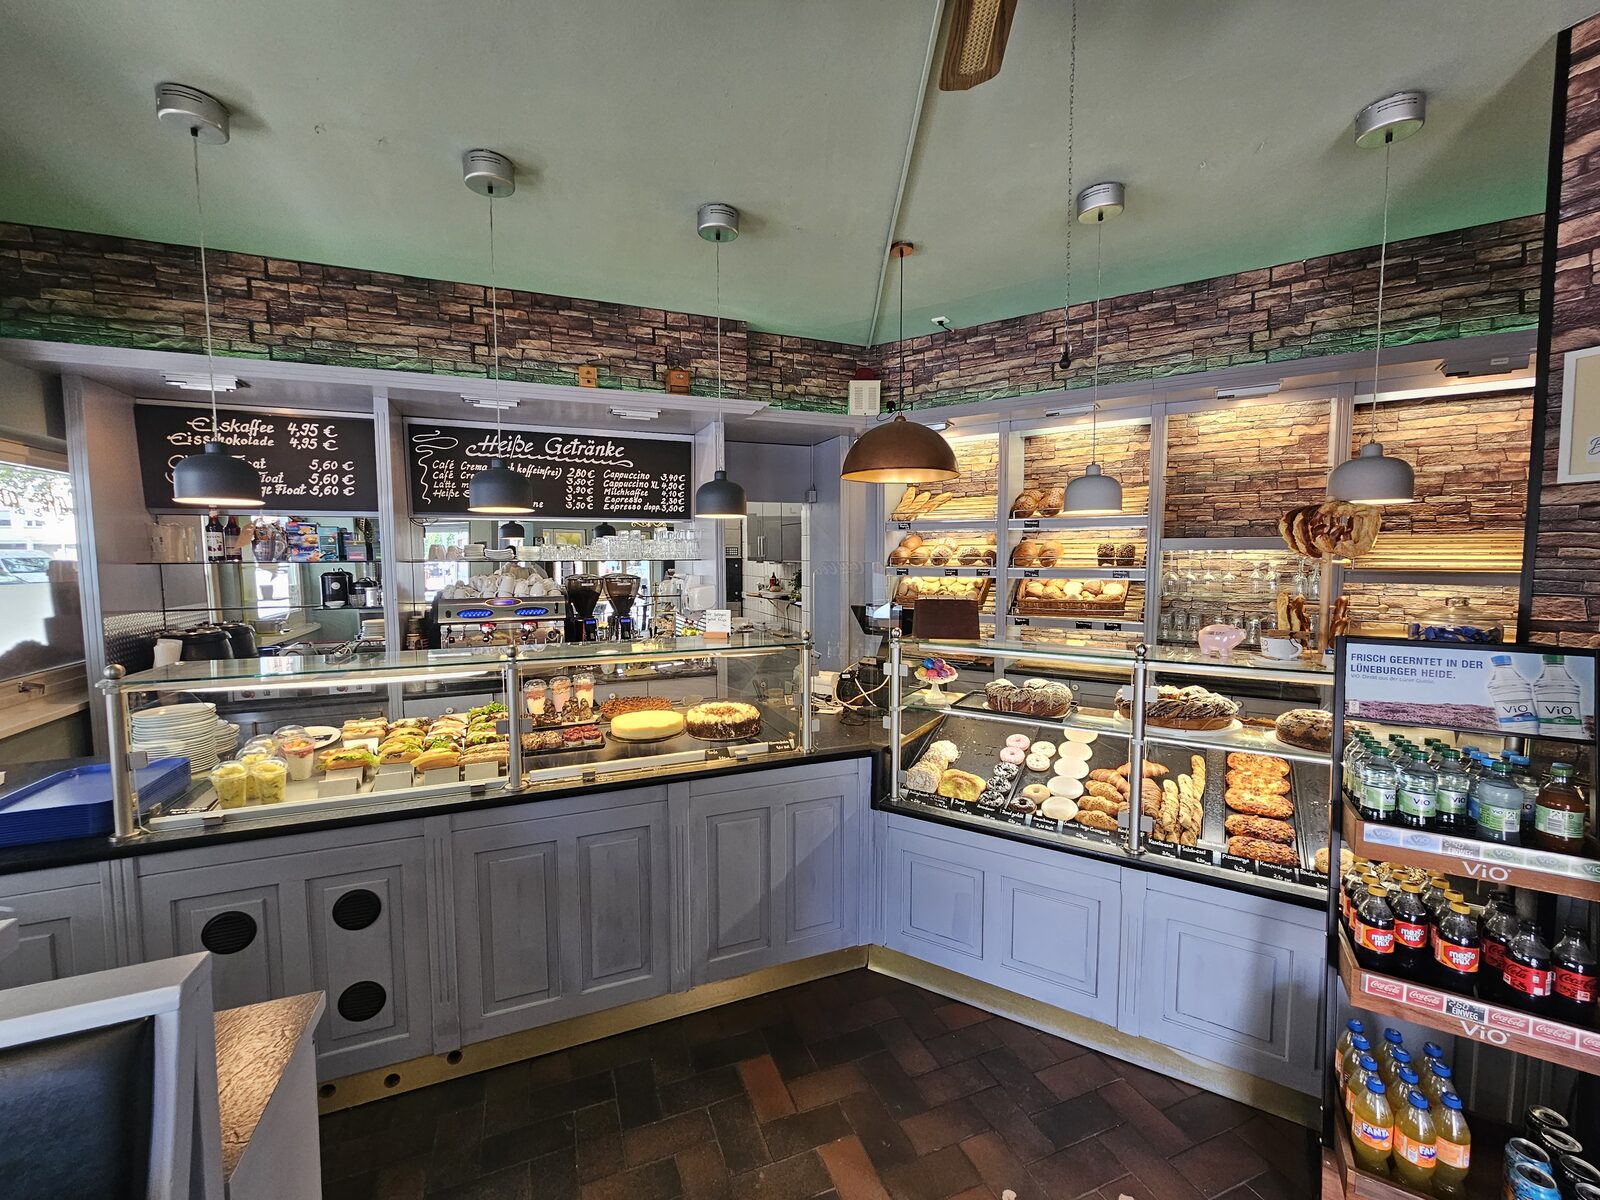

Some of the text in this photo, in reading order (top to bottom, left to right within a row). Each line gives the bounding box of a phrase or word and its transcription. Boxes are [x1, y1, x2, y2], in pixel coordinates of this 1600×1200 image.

[287, 422, 319, 437] 4,95
[323, 425, 338, 438] €
[289, 437, 318, 450] 4,95
[322, 439, 339, 451] €
[478, 434, 625, 459] Heiße Getränke
[308, 459, 355, 472] 5,60 €
[432, 459, 455, 473] Café
[460, 461, 488, 471] Crema
[516, 463, 563, 480] koffeinfrei)
[308, 473, 339, 486] 5,60
[341, 474, 355, 485] €
[432, 471, 454, 482] Café
[603, 469, 651, 480] Cappuccino
[275, 483, 307, 496] Float
[309, 485, 339, 497] 5,60
[342, 486, 355, 496] €
[433, 481, 457, 489] Latte
[603, 479, 649, 490] Cappuccino
[650, 481, 660, 489] XL
[432, 489, 460, 501] Heiße
[603, 488, 649, 498] Milchkaffee
[604, 496, 643, 504] Espresso
[603, 504, 641, 513] Espresso
[1351, 653, 1483, 669] FRISCH GEERNTET IN DER
[1350, 663, 1456, 680] LÜNEBURGER HEIDE.
[1503, 704, 1528, 713] ViO
[1545, 705, 1573, 715] ViO
[1413, 798, 1431, 806] ViO
[1462, 860, 1509, 881] ViO
[1403, 934, 1420, 942] mix
[1452, 957, 1471, 966] mix
[1451, 1007, 1479, 1021] EINWEG
[1460, 1020, 1508, 1045] ViO
